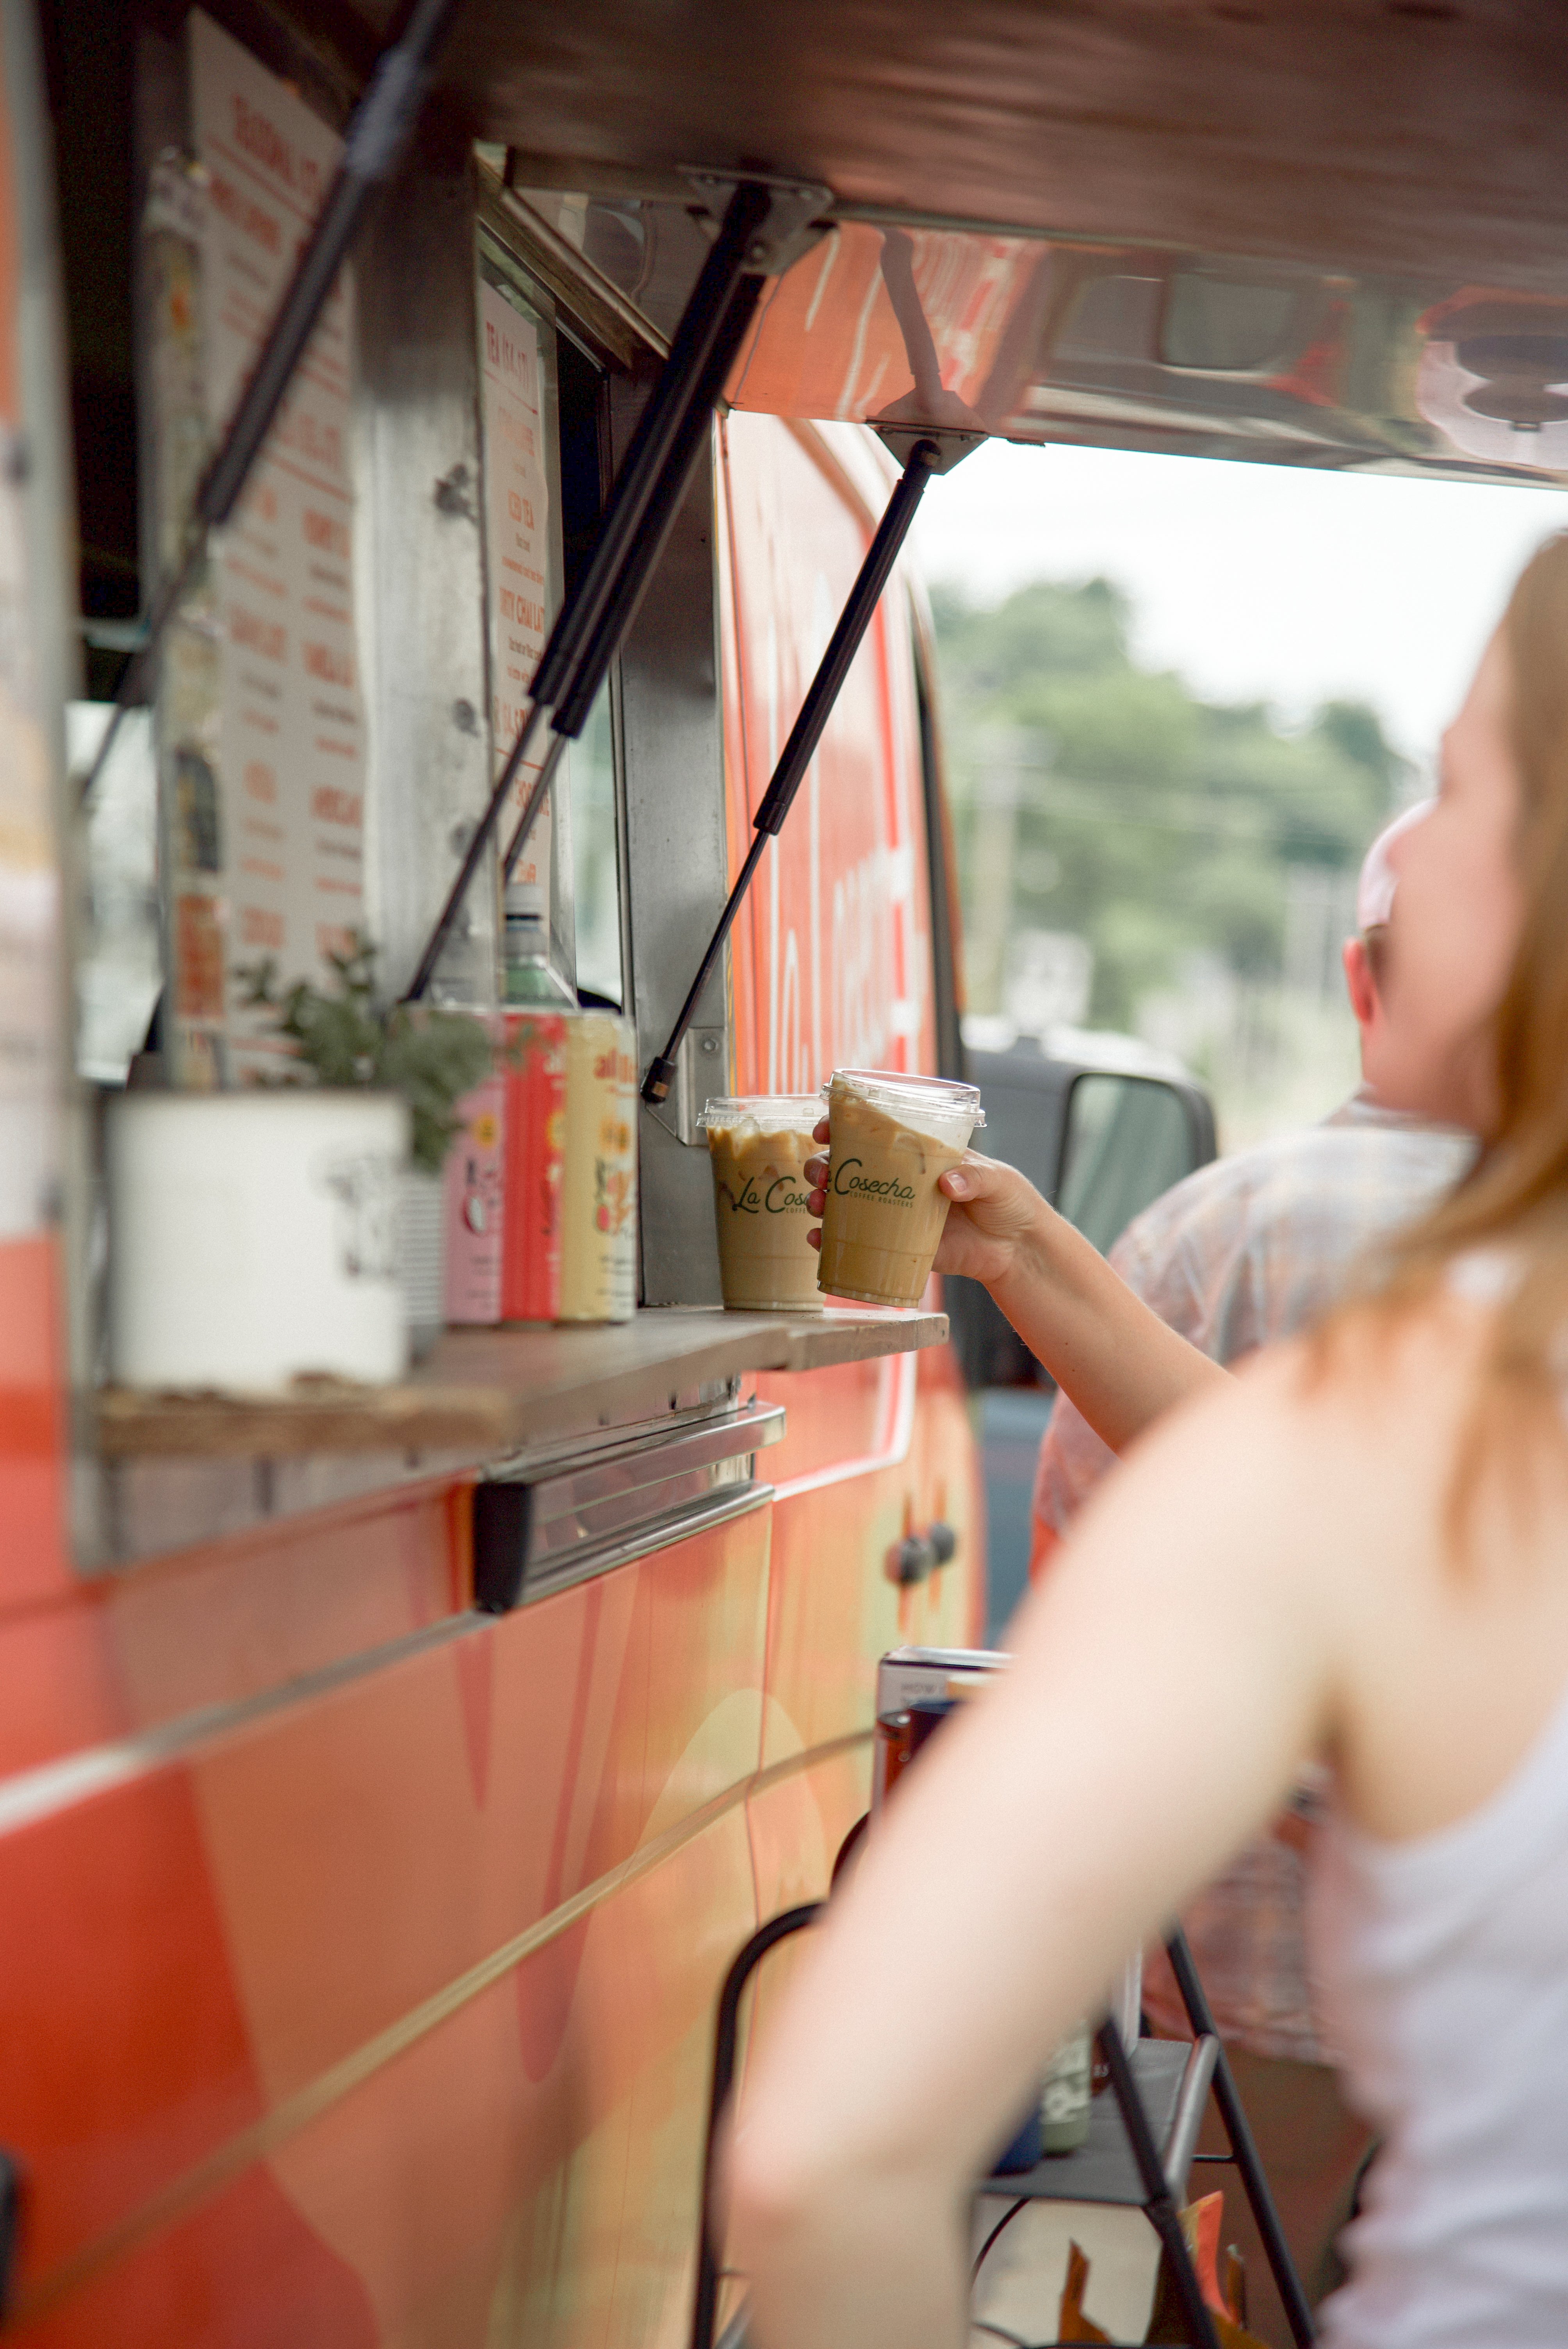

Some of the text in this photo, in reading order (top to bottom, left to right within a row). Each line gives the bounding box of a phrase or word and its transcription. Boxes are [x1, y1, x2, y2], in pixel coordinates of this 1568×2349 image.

[732, 1176, 807, 1214] La Cos
[834, 1158, 916, 1199] Cosecha
[850, 1191, 914, 1208] COFFEE ROASTERS
